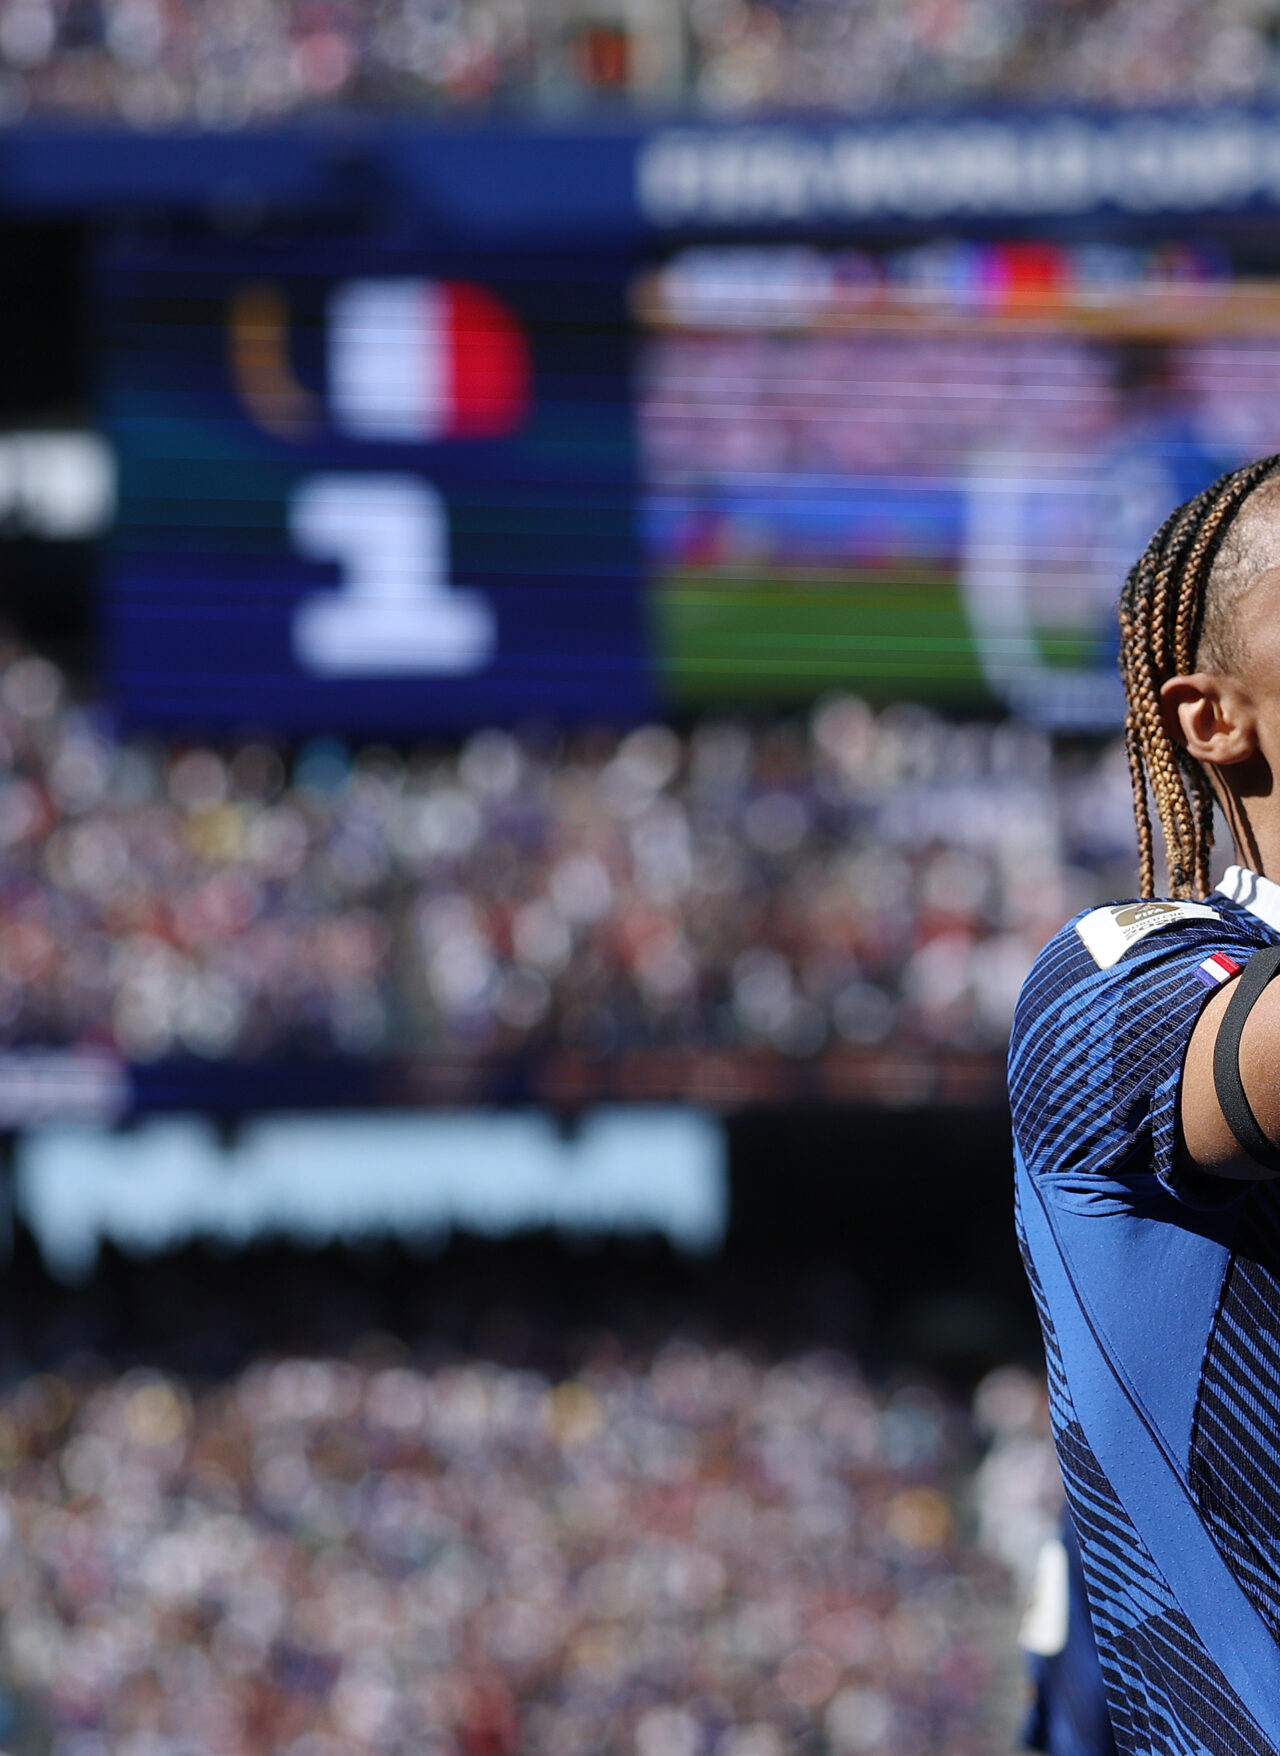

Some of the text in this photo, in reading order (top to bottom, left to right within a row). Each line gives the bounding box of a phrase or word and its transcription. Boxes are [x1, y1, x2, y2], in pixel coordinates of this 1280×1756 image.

[290, 471, 495, 677] 1
[1122, 911, 1185, 934] WORLD CUP
